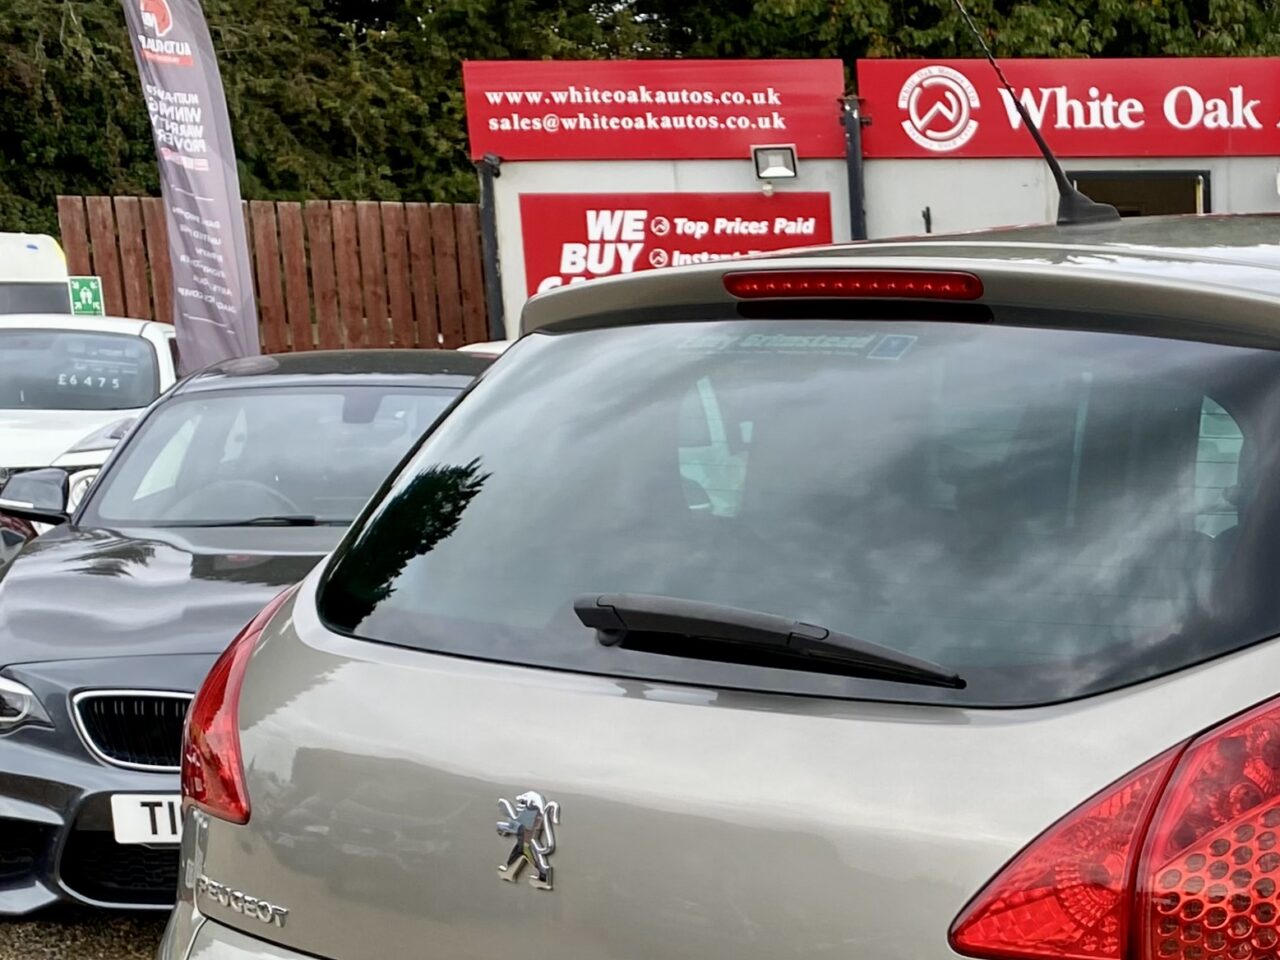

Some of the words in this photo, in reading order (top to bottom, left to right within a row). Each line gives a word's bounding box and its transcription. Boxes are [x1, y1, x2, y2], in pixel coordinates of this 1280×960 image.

[485, 86, 782, 106] www.whiteoakautos.co.uk
[997, 86, 1145, 131] White
[1164, 85, 1264, 129] Oak
[488, 112, 788, 132] sales@whiteoakautos.co.uk
[585, 209, 648, 241] WE
[673, 217, 709, 240] Top
[714, 216, 769, 236] Prices
[774, 217, 816, 235] Paid
[560, 243, 645, 274] BUY
[197, 875, 290, 928] PEUGEOT
